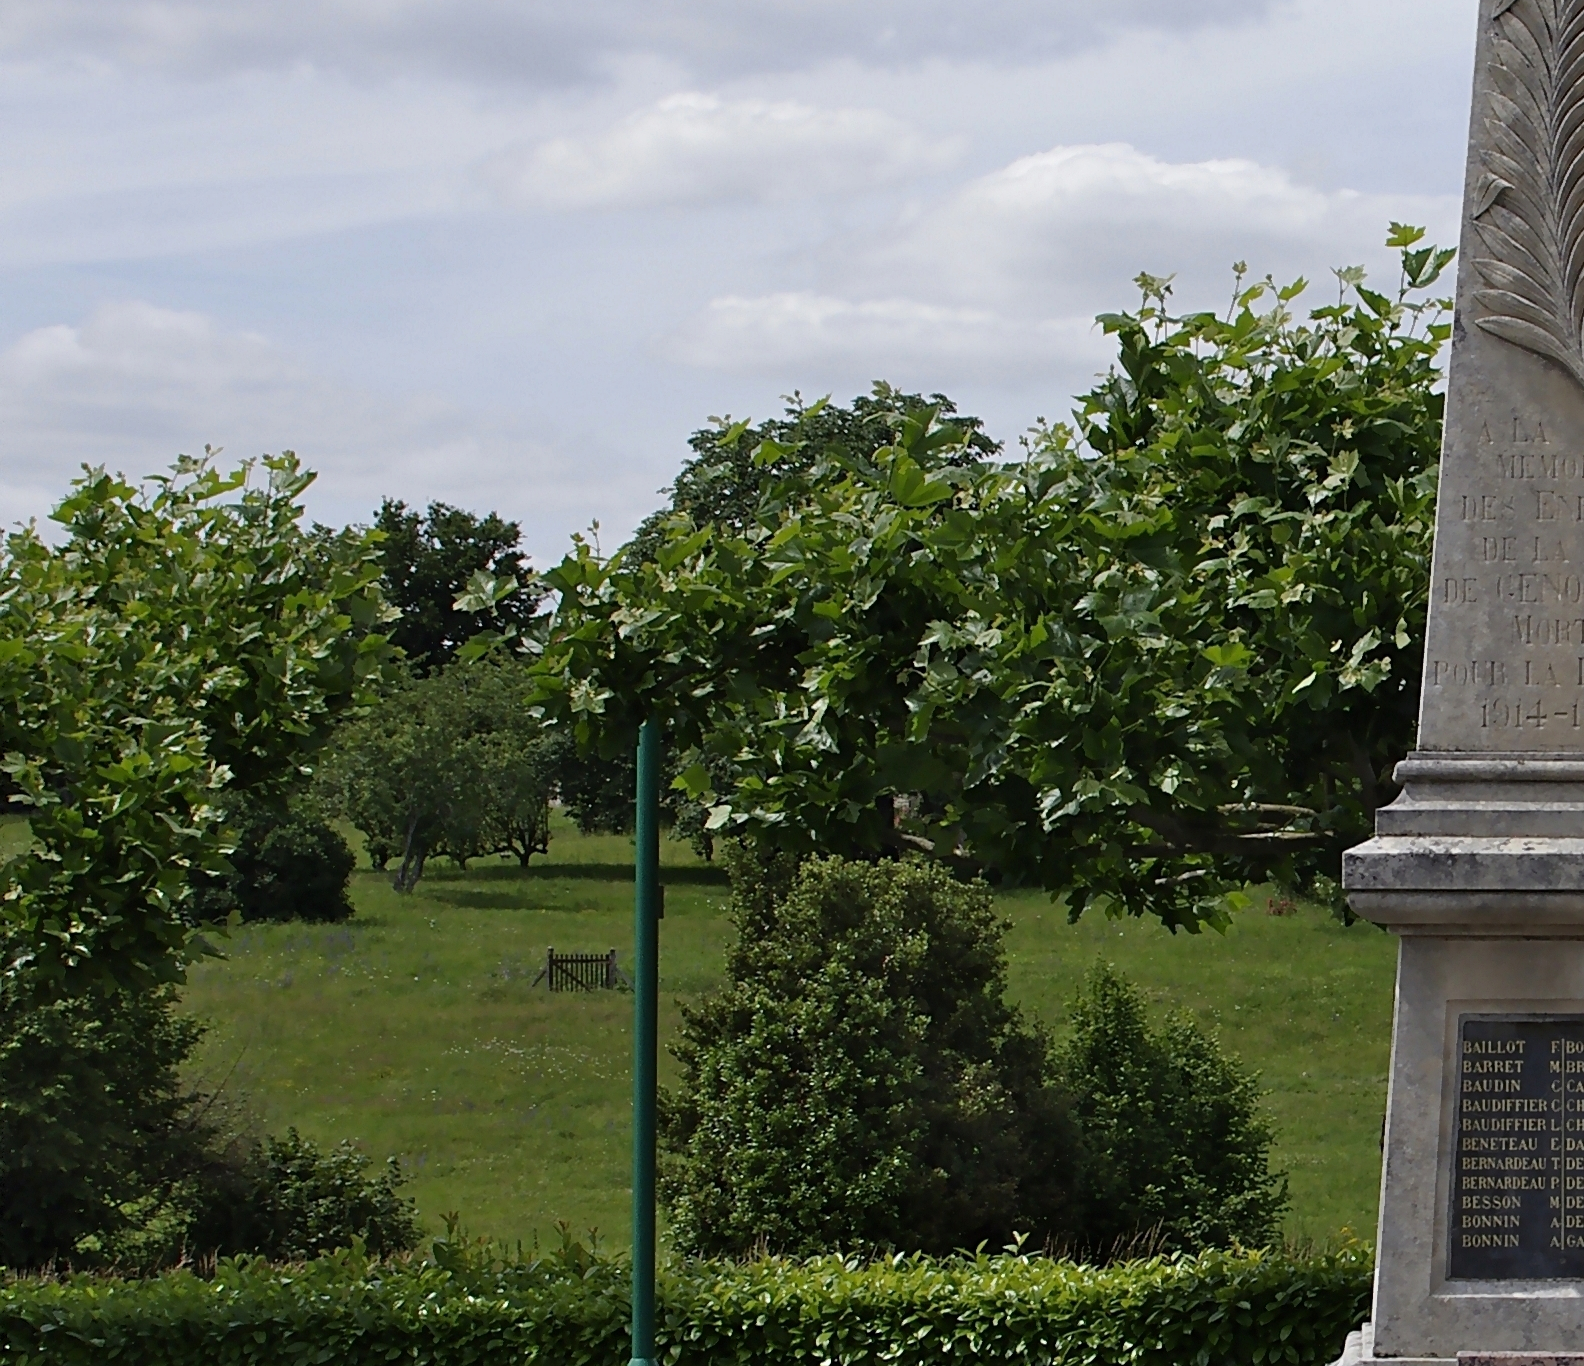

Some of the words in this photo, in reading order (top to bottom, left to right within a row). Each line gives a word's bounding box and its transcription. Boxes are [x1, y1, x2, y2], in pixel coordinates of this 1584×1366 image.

[1478, 420, 1494, 444] A
[1512, 417, 1550, 444] LA
[1461, 495, 1517, 522] DES
[1483, 536, 1517, 563] DE
[1532, 536, 1570, 564] LA
[1443, 578, 1478, 604] DE
[1433, 660, 1506, 687] POUR
[1525, 660, 1561, 687] LA
[1463, 1040, 1526, 1054] BAILLOT
[1463, 1060, 1524, 1073] BARRET
[1462, 1079, 1521, 1093] BAUDIN
[1462, 1099, 1547, 1112] BAUDIFFIER
[1462, 1118, 1546, 1131] BAUDIFFIER
[1462, 1137, 1538, 1151] BENETEAU
[1462, 1157, 1546, 1170] BERNARDEAU
[1462, 1176, 1546, 1190] BERNARDEAU
[1462, 1195, 1521, 1209] BESSON
[1462, 1215, 1520, 1228] BONNIN
[1462, 1234, 1520, 1248] BONNIN
